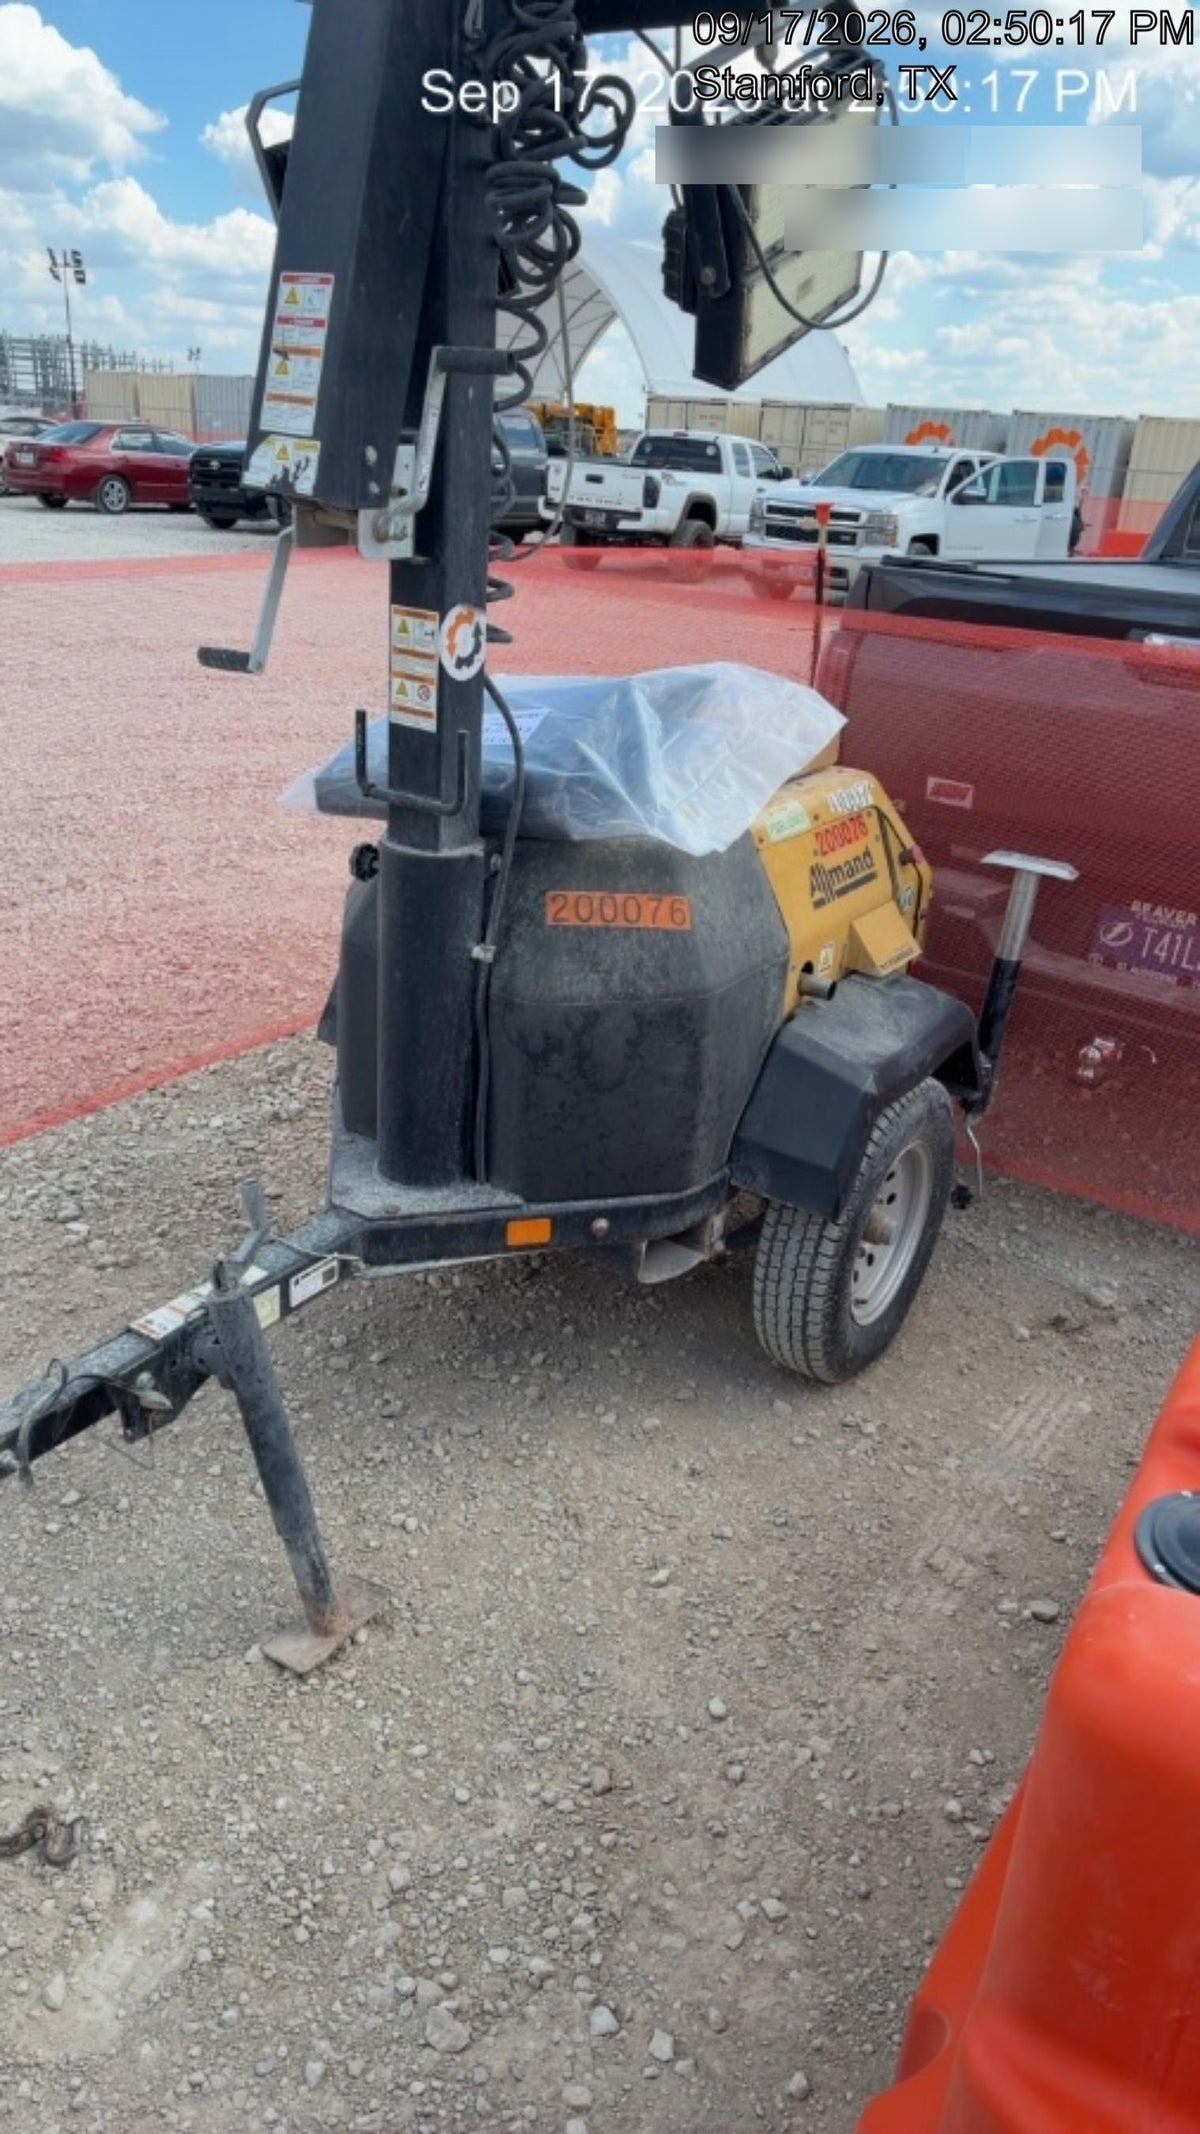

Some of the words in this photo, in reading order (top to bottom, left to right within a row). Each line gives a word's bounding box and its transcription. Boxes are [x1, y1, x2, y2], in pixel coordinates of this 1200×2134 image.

[813, 813, 869, 857] 200076
[810, 843, 875, 905] Allmand
[550, 894, 688, 926] 200076
[1142, 926, 1200, 971] T41L
